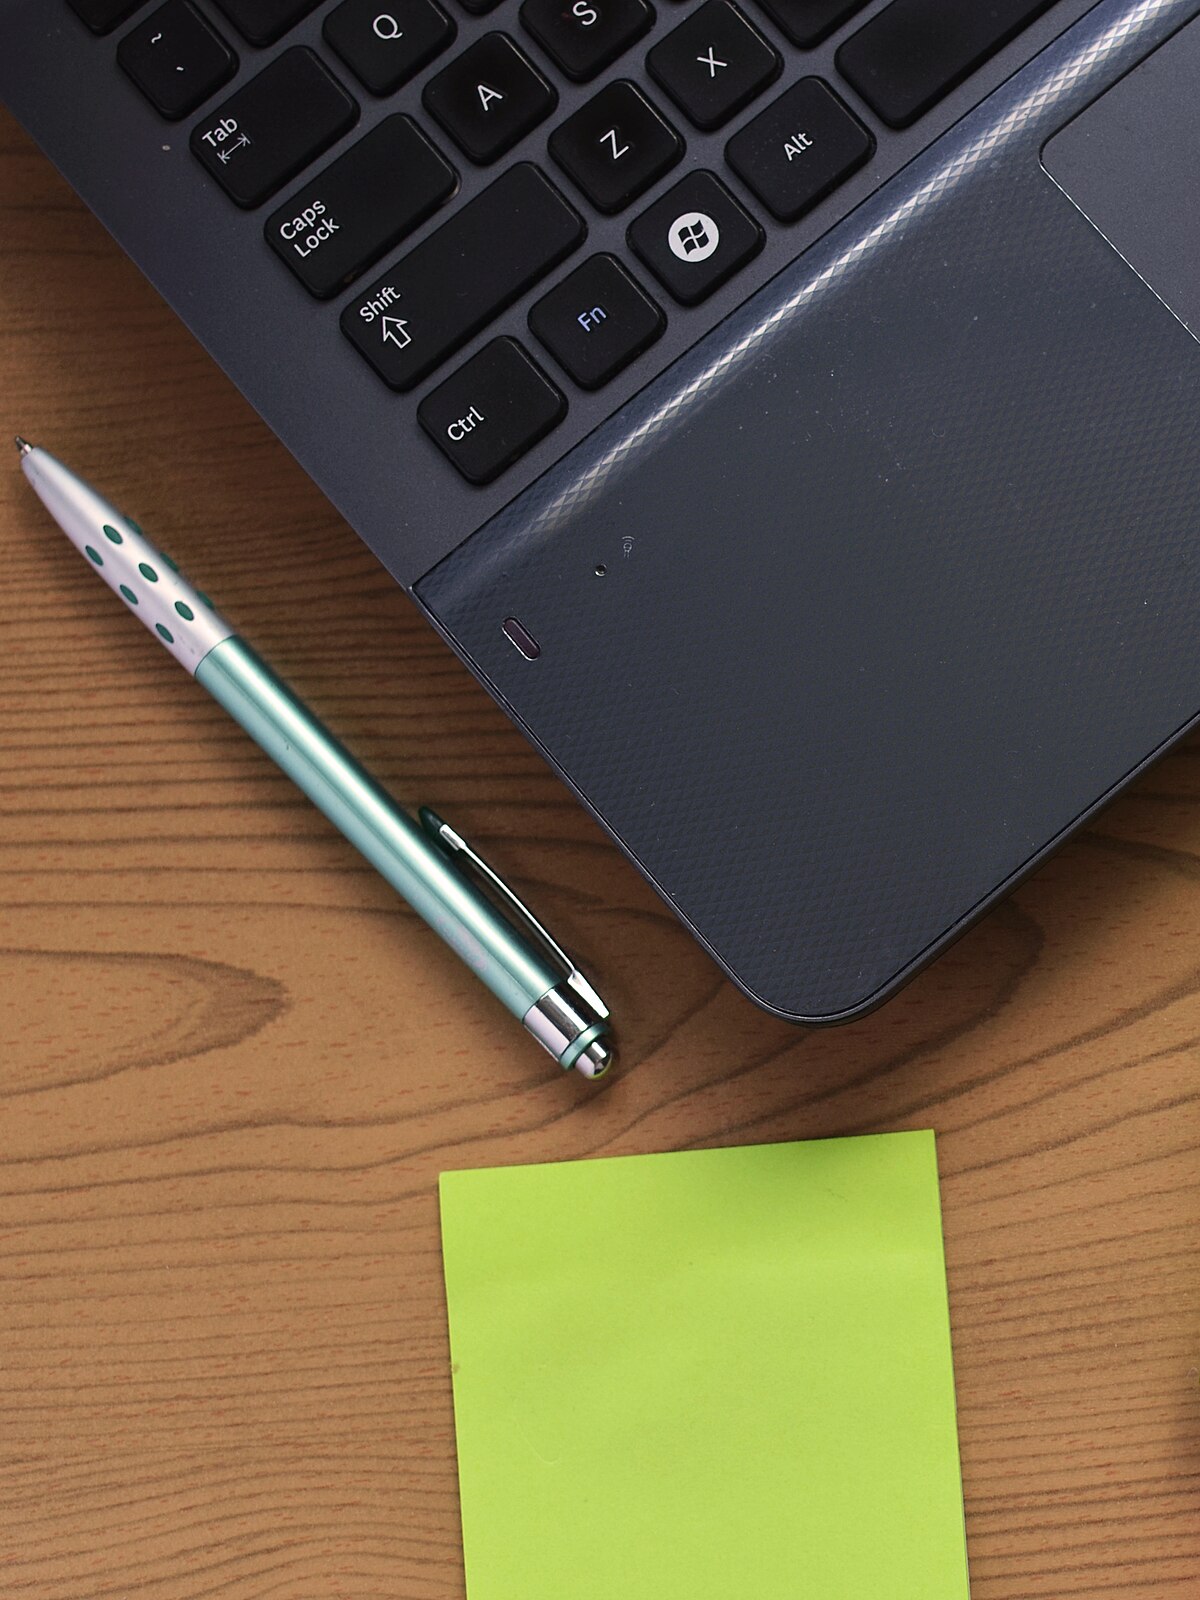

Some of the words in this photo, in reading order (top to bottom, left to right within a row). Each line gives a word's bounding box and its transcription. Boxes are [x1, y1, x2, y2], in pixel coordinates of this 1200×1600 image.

[372, 14, 403, 40] Q
[572, 0, 598, 26] S
[696, 46, 728, 78] X
[477, 84, 503, 112] A
[202, 118, 239, 147] Tab
[599, 129, 630, 160] Z
[784, 132, 813, 161] Alt
[280, 200, 326, 241] Caps
[293, 217, 341, 258] Lock
[359, 286, 401, 323] Shift
[577, 305, 607, 332] Fn
[447, 406, 485, 442] Ctrl
